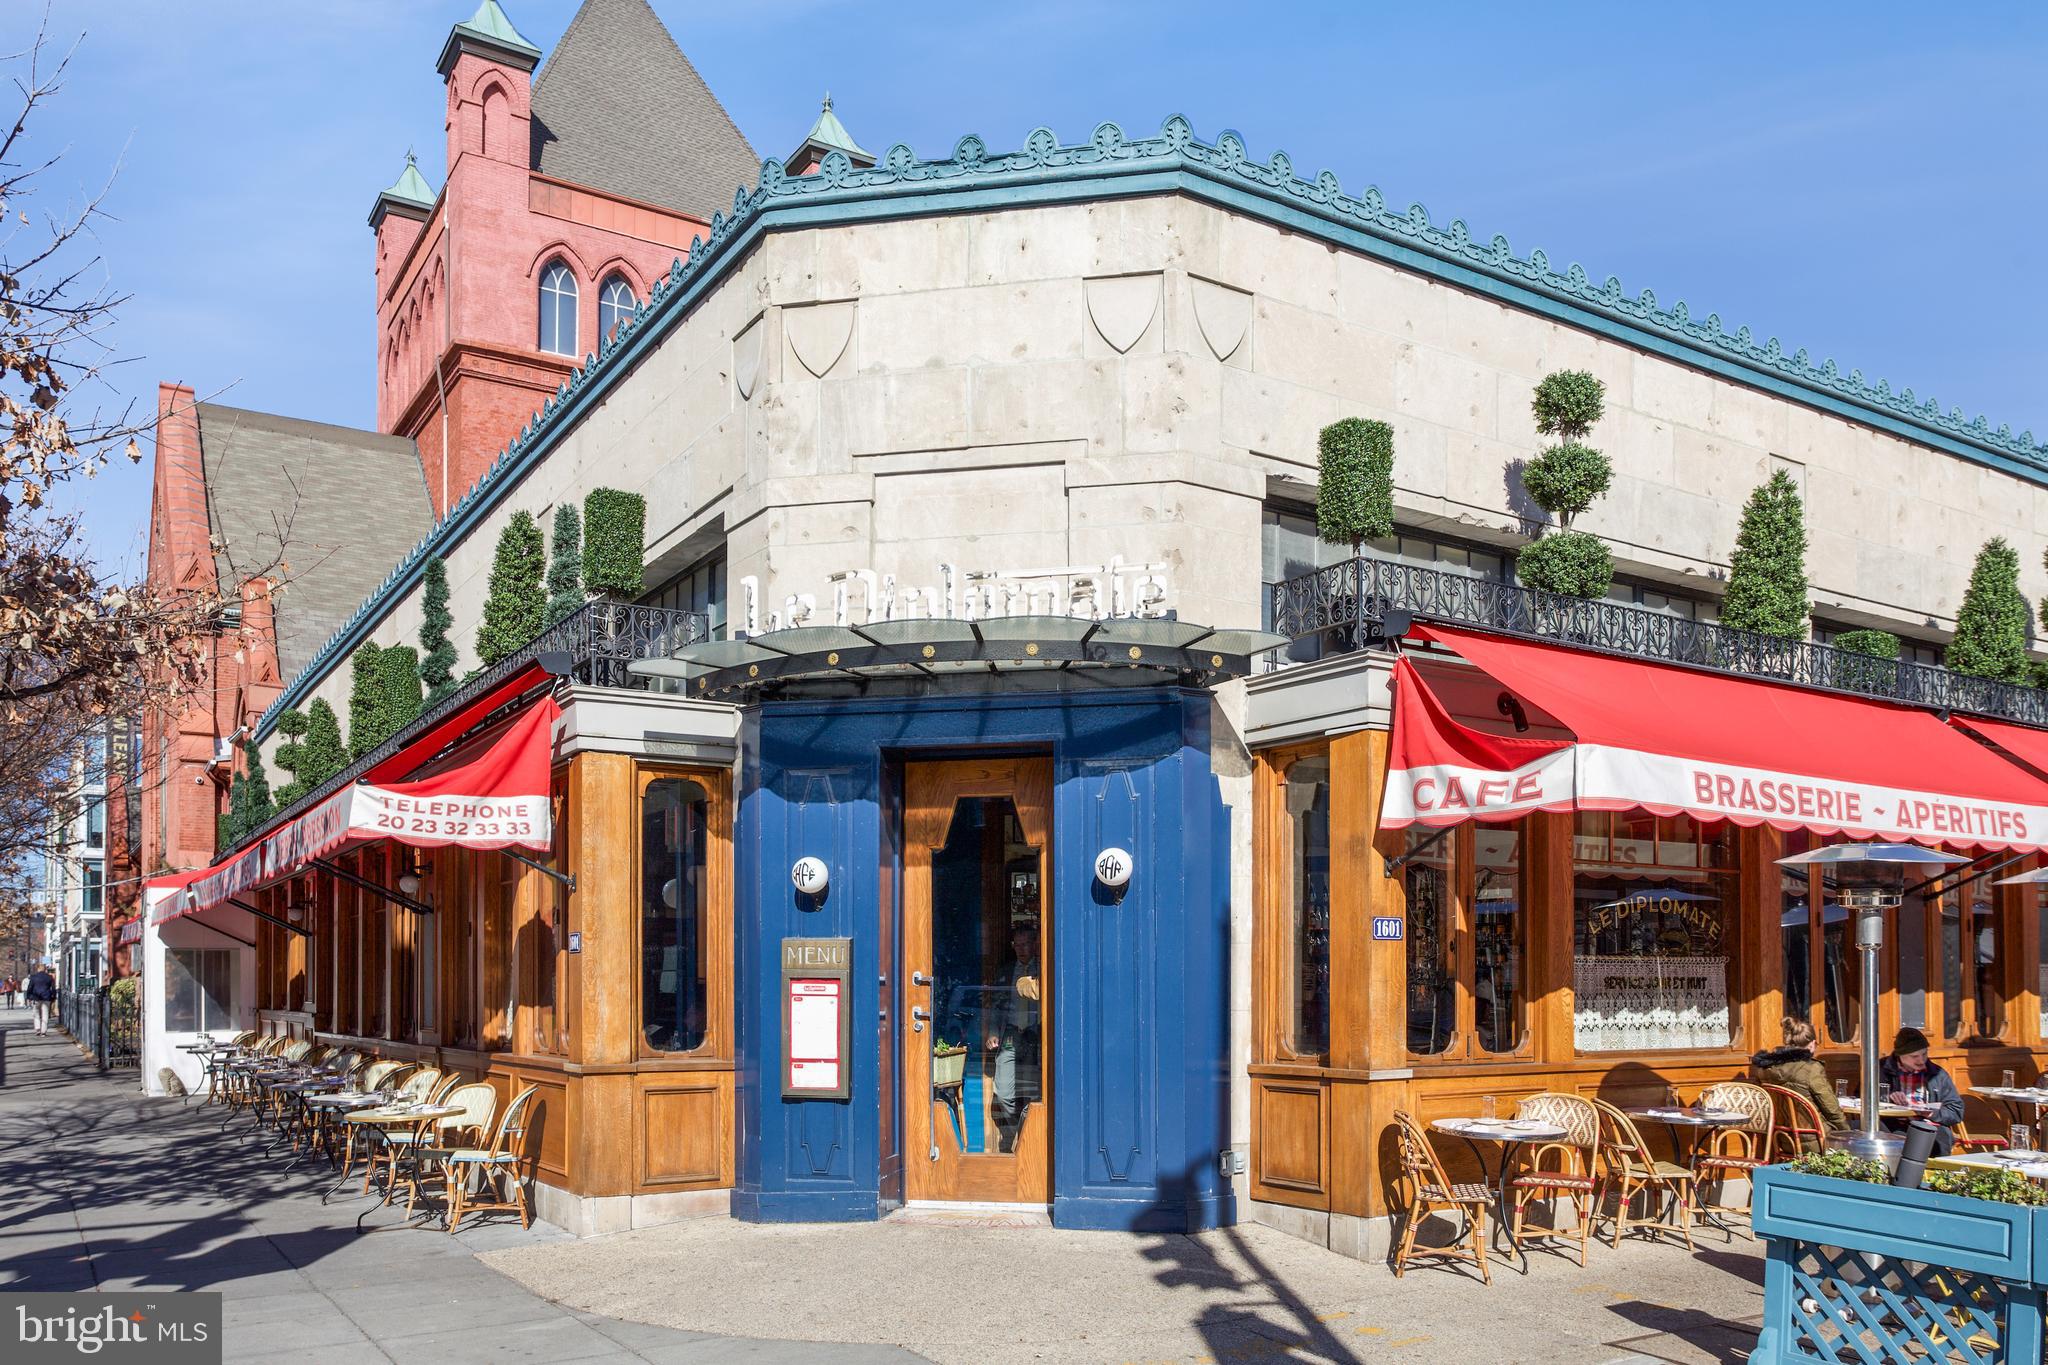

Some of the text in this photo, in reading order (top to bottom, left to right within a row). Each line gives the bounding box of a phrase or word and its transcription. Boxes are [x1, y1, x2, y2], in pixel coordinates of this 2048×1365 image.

[379, 796, 528, 819] TELEPHONE
[1693, 770, 1862, 822] BRASSERIE
[1896, 797, 2028, 840] APÉRITIFS
[377, 814, 531, 836] 20 23 32 33 33
[1376, 920, 1400, 937] 1601
[1588, 896, 1721, 940] LE DIPLOMATE
[786, 946, 845, 965] MENU
